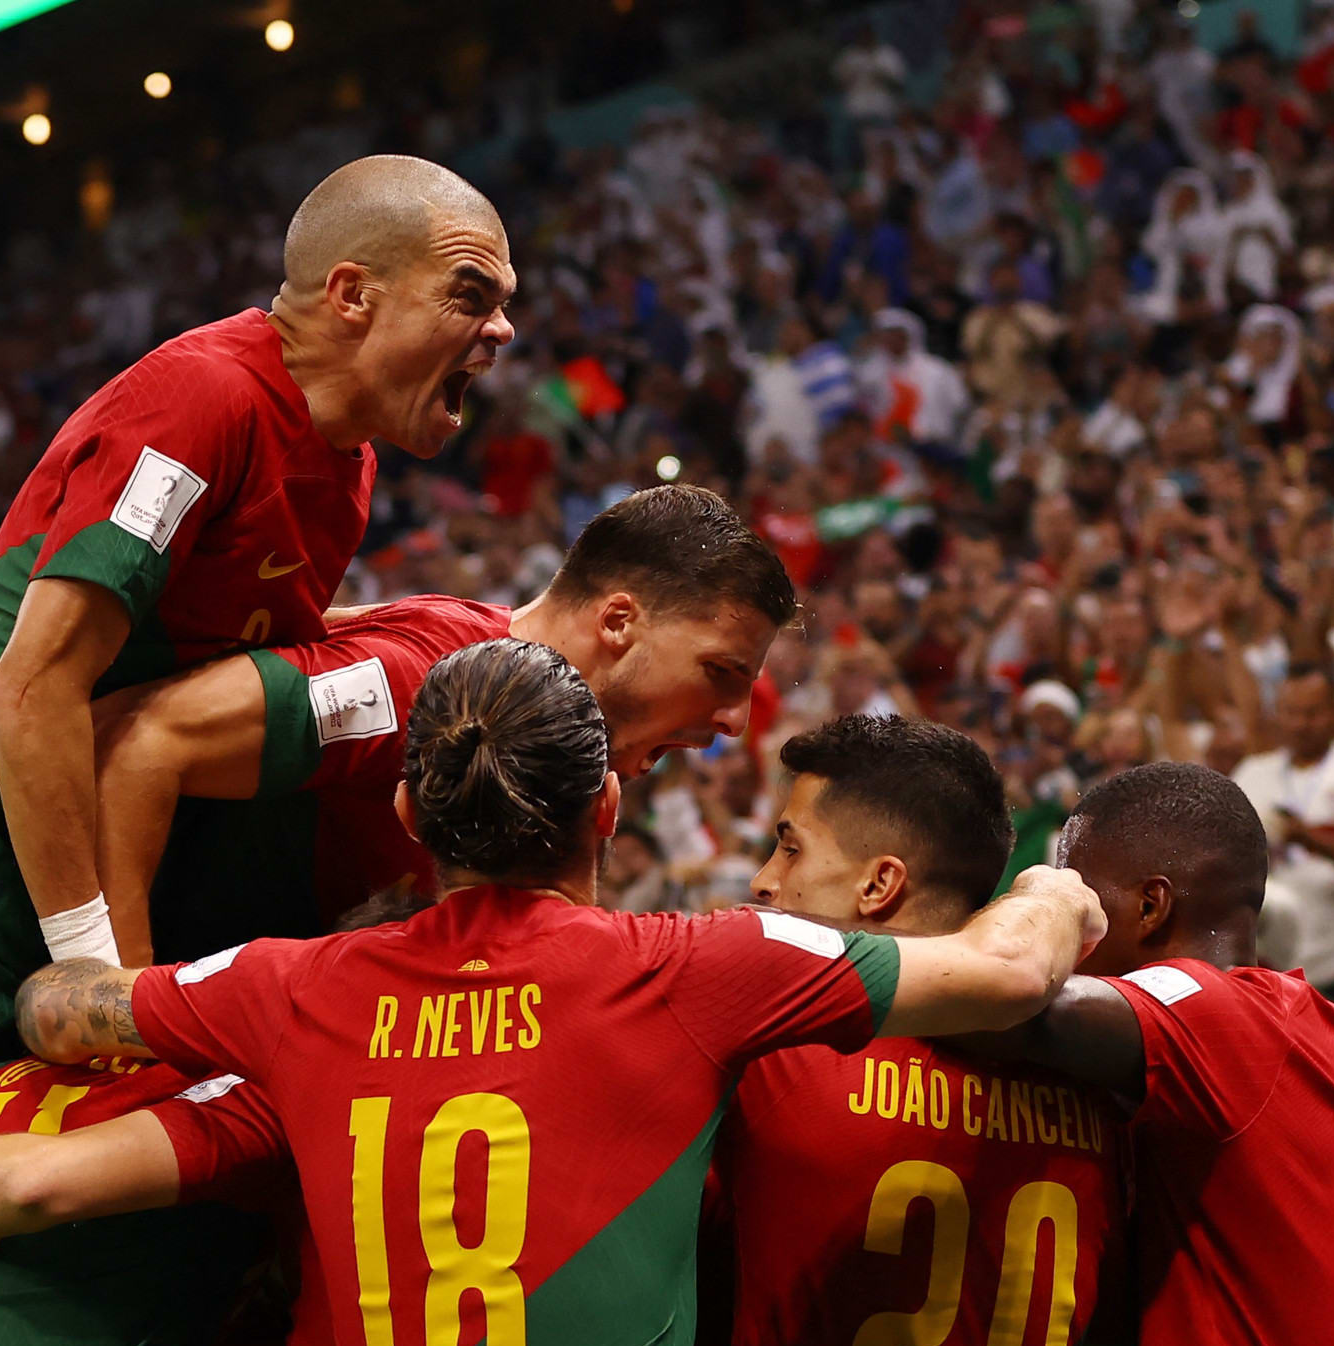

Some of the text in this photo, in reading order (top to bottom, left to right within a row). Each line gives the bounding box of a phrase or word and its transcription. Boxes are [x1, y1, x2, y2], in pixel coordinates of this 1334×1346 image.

[369, 983, 542, 1059] R. NEVES
[848, 1057, 950, 1130] JOÃO
